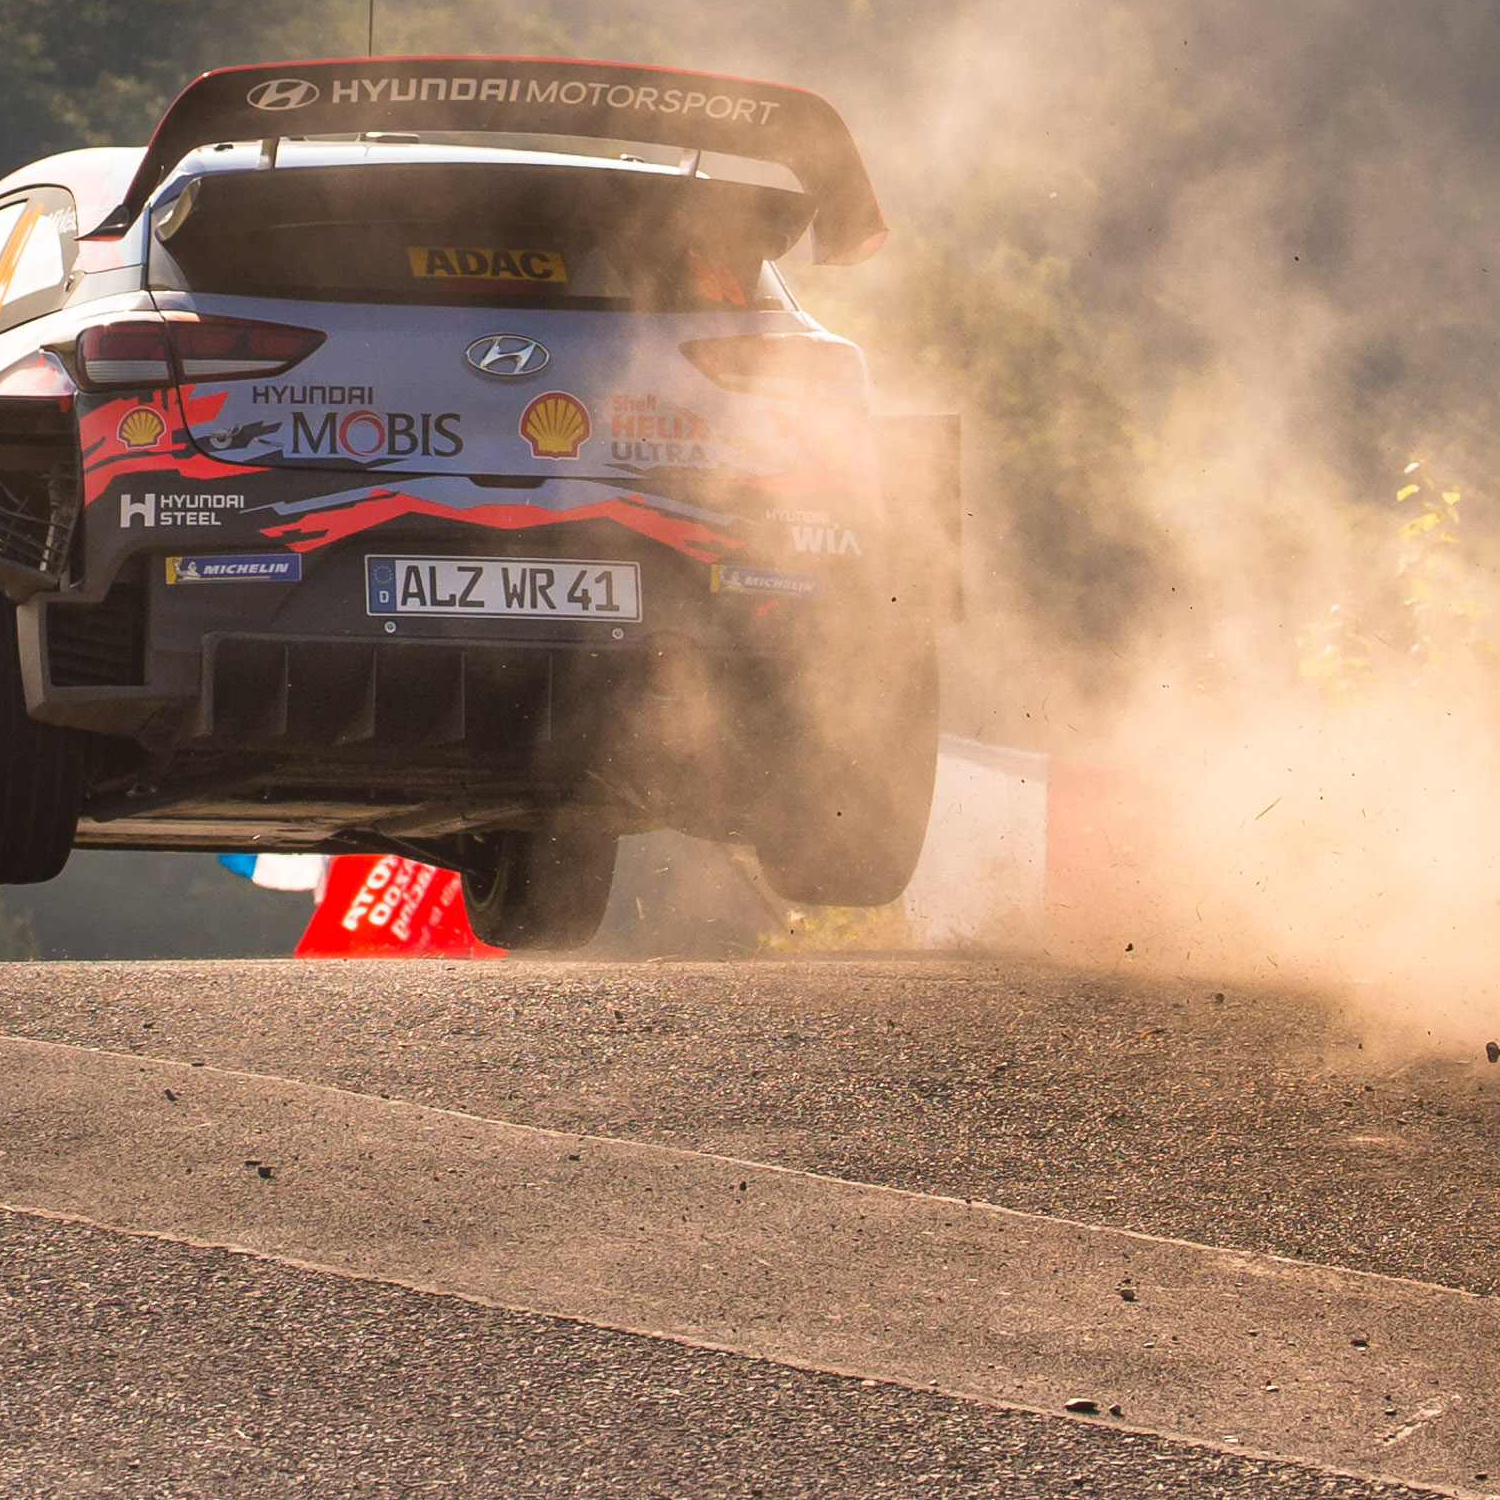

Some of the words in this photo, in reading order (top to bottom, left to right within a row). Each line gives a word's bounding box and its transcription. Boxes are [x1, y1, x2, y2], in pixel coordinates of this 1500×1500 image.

[331, 78, 518, 103] HYUNDAI
[525, 79, 779, 126] MOTORSPORT
[425, 249, 553, 280] ADAC
[252, 385, 373, 405] HYUNDAI
[611, 394, 657, 412] Shell
[290, 409, 464, 457] MOBIS
[611, 414, 711, 441] HELIX
[611, 441, 709, 463] ULTRA
[160, 494, 245, 509] HYUNDAI
[160, 512, 222, 526] STEEL
[765, 508, 830, 524] HYUNDAI
[203, 562, 289, 575] MICHELIN
[400, 564, 485, 608] ALZ
[501, 567, 557, 610] WR
[566, 569, 621, 612] 41
[744, 576, 815, 592] MICHELIN
[378, 590, 389, 604] D
